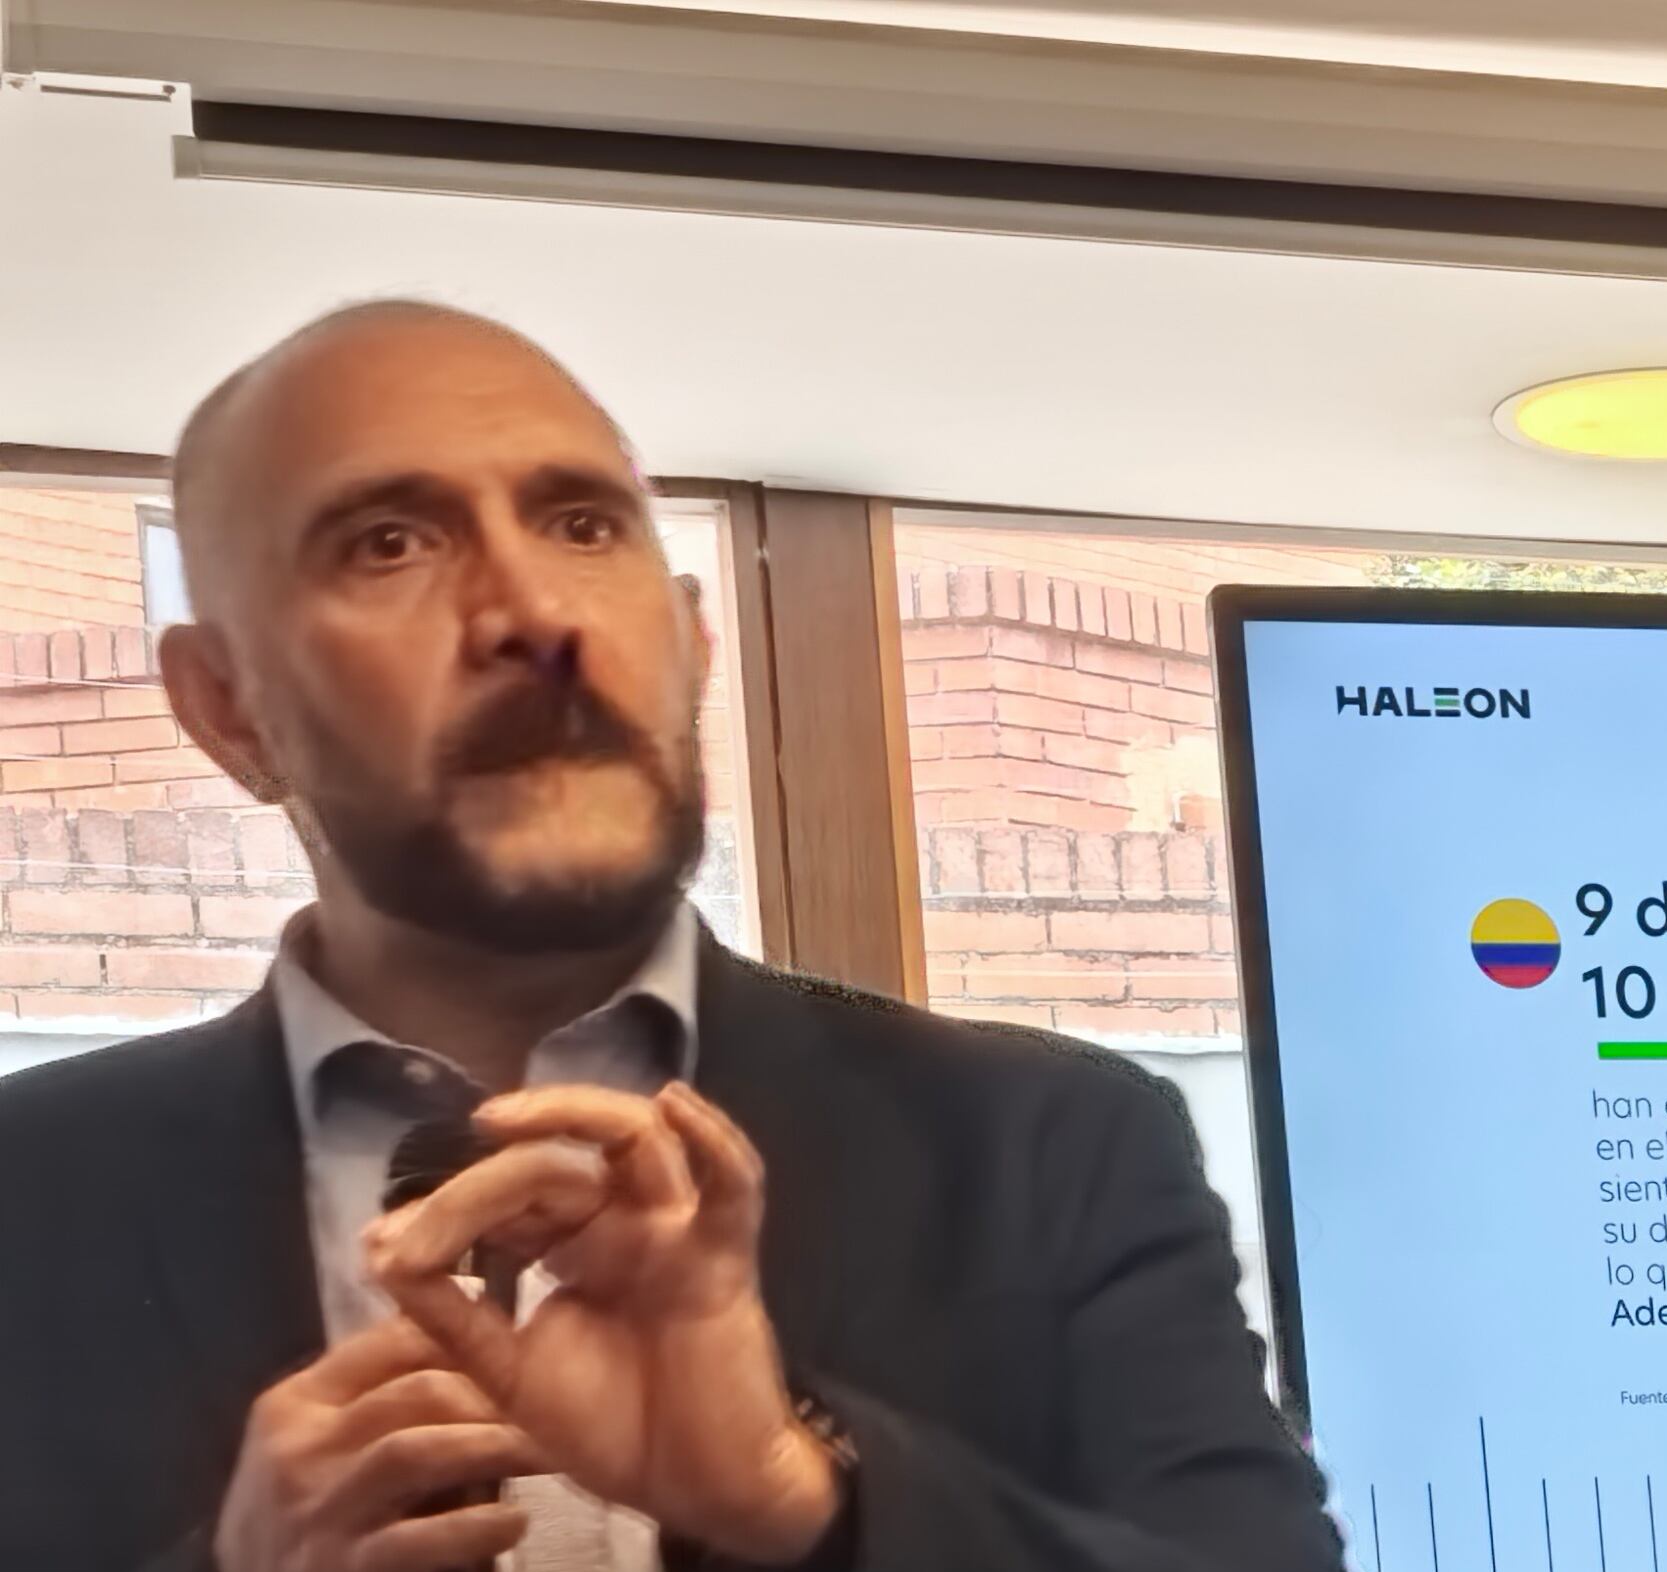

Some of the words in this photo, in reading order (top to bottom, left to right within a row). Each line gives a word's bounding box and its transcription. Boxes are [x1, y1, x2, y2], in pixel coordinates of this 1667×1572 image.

[1335, 685, 1531, 720] HALEON
[1575, 882, 1614, 937] 9
[1581, 965, 1657, 1020] 10
[1591, 1087, 1653, 1120] han
[1595, 1138, 1635, 1161] en
[1602, 1222, 1638, 1245] su
[1606, 1255, 1635, 1286] lo
